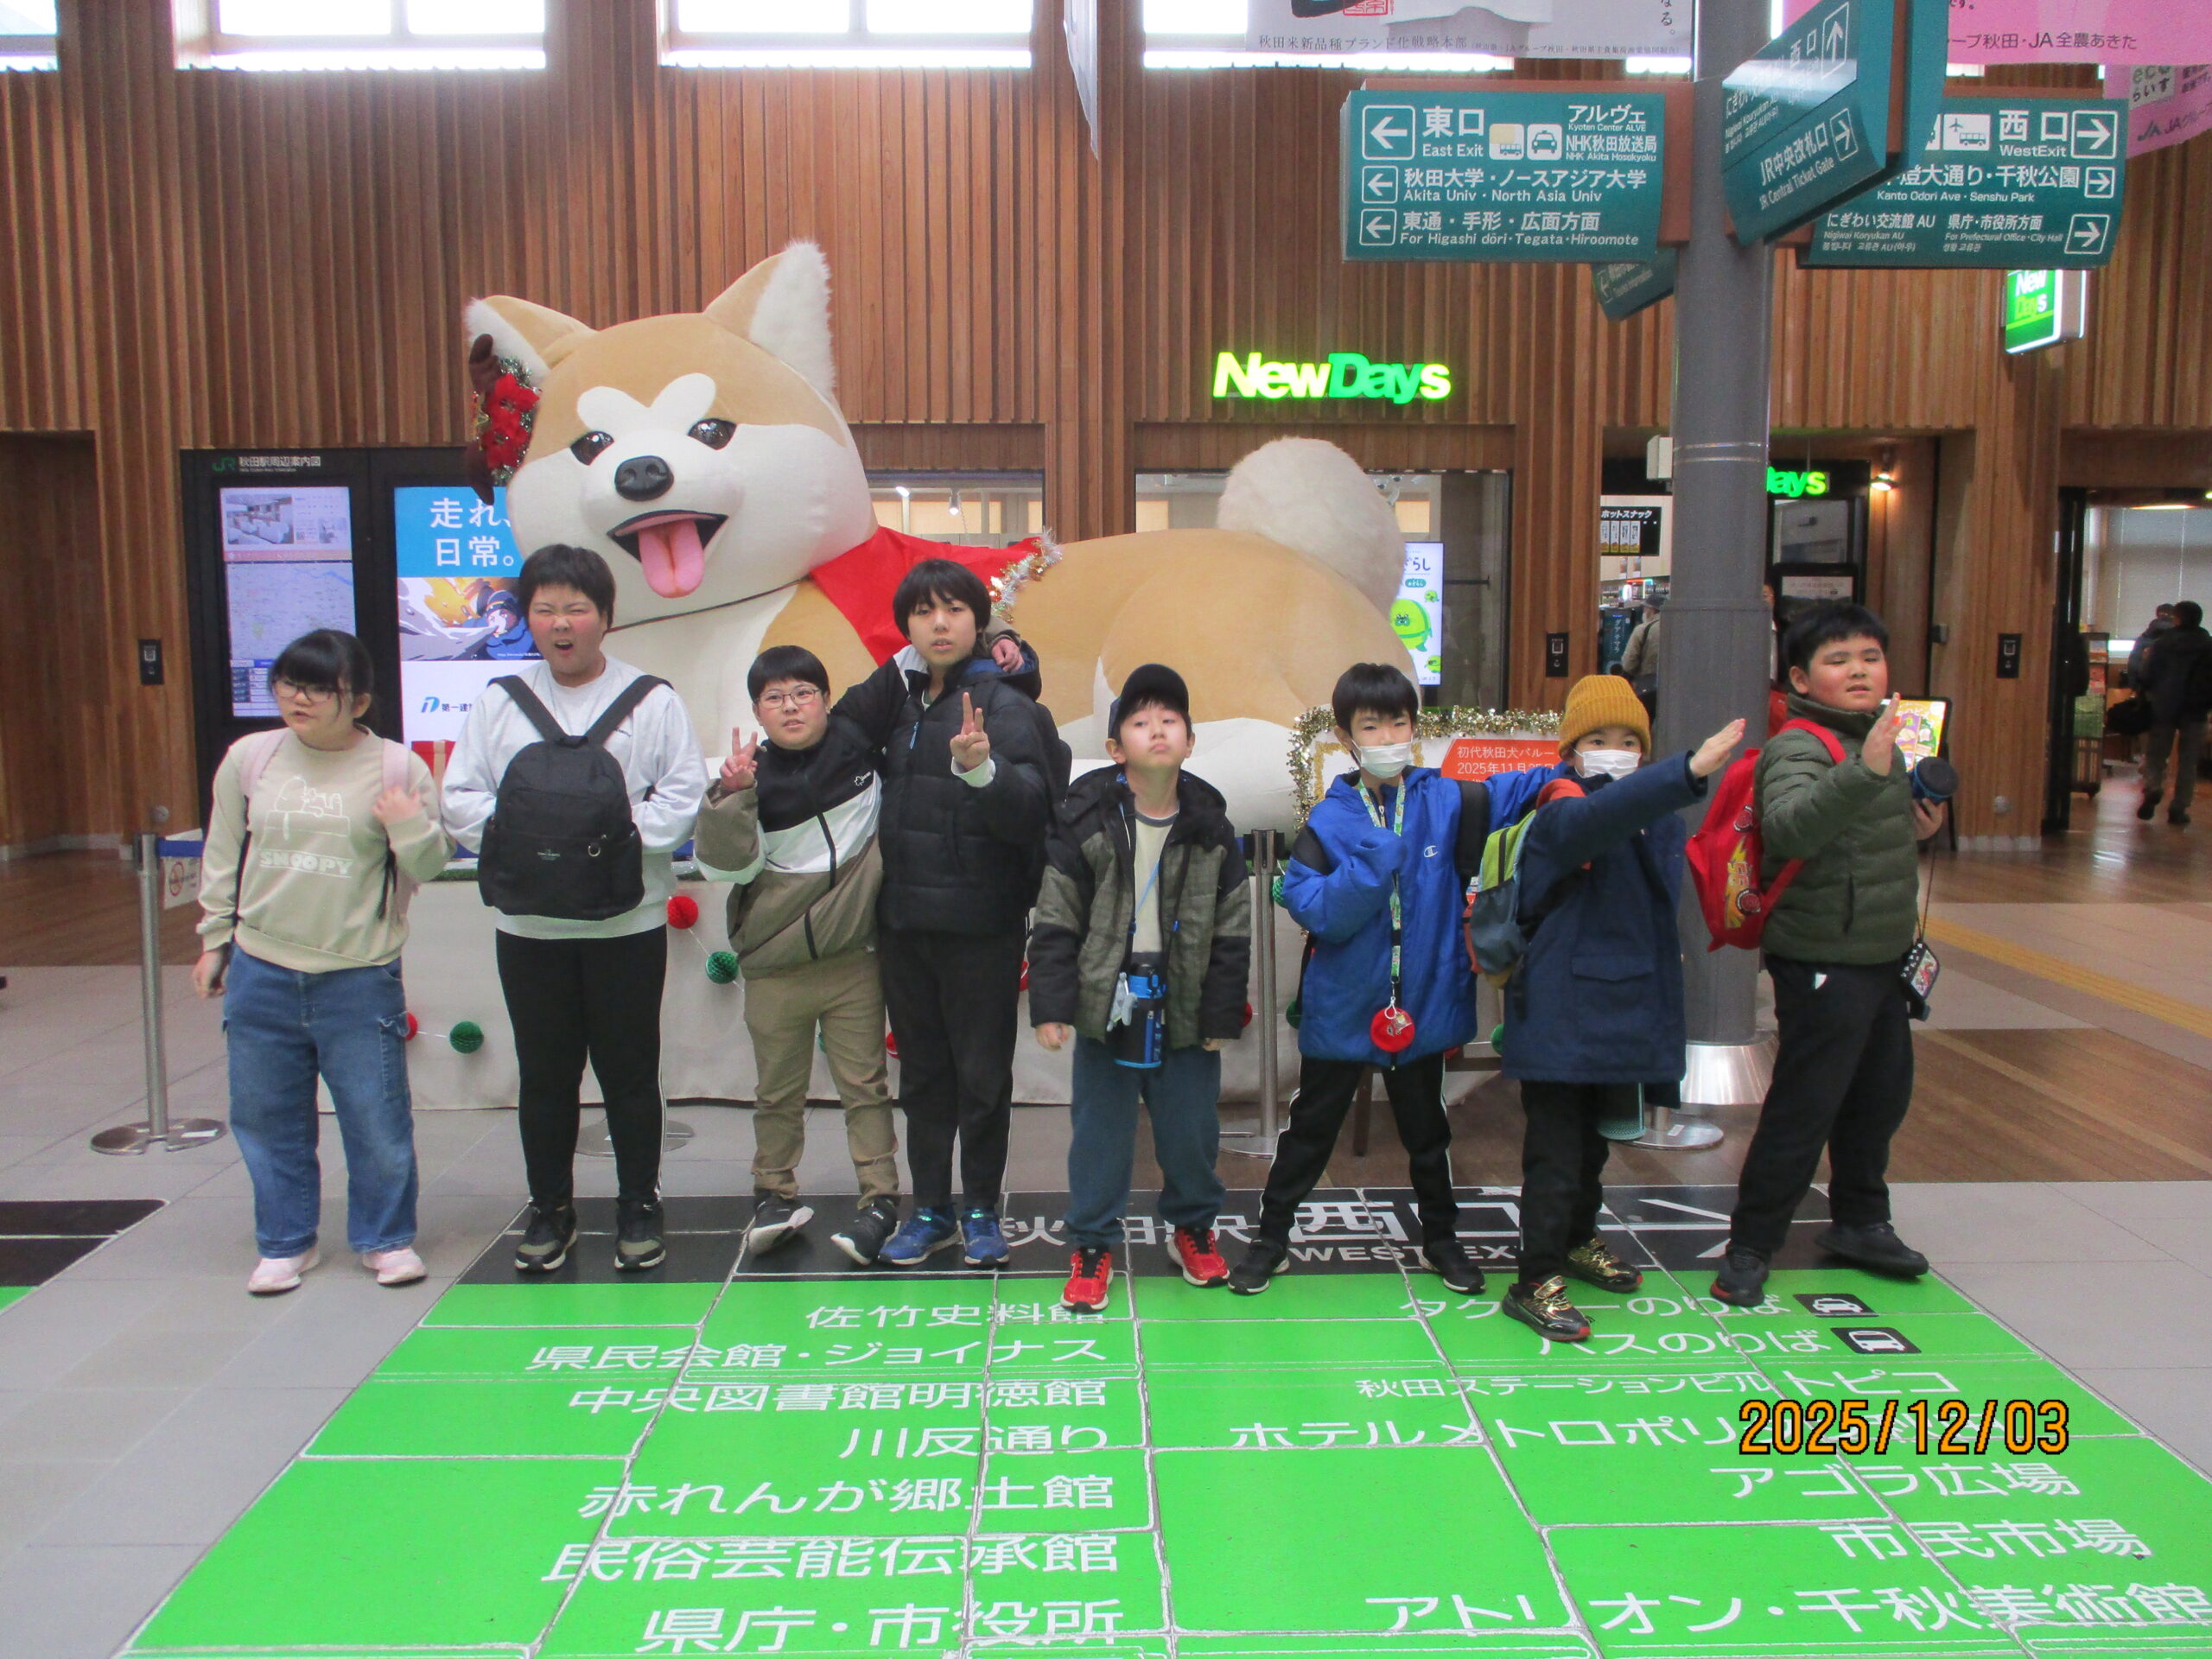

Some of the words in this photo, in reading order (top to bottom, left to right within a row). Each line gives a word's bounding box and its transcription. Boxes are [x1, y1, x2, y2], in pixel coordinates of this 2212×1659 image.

[1947, 32, 2138, 50] ープ秋田・JA全農あきた
[1422, 105, 1484, 138] 東口
[1568, 104, 1646, 124] アルヴェ
[1999, 110, 2069, 141] 西口
[1598, 124, 1624, 132] Center
[1422, 143, 1452, 157] East
[1457, 143, 1484, 157] Exit
[1566, 135, 1657, 153] NHK秋田放送局
[1760, 122, 1829, 187] JR中央改札口
[1768, 179, 1794, 204] Central
[1792, 167, 1817, 188] Ticket
[1815, 157, 1835, 175] Gate
[1887, 164, 2081, 188] 燈大通り・千秋公園
[1403, 189, 1441, 201] Akita
[1446, 190, 1477, 201] Univ
[1492, 190, 1530, 201] North
[1536, 190, 1566, 202] Asia
[1572, 190, 1602, 202] Univ
[1877, 191, 1908, 200] Kanto
[1910, 191, 1938, 200] Odori
[1940, 192, 1961, 201] Ave
[1970, 192, 2008, 202] Senshu
[2011, 193, 2035, 202] Park
[1827, 213, 1915, 230] にぎわい交流館
[1916, 214, 1936, 228] AU
[1948, 213, 2044, 231] 県庁・市役所方面
[1400, 233, 1423, 245] For
[1428, 232, 1477, 245] Higashi
[1945, 232, 1958, 241] For
[429, 498, 512, 529] 走れ、
[1601, 510, 1652, 518] ホットスナック
[435, 535, 514, 567] 日常。
[1457, 747, 1555, 759] 初代秋田犬バルー
[260, 851, 353, 874] SNOOPY
[805, 1303, 1104, 1328] 佐竹史料館
[524, 1338, 1107, 1371] 県民会館・ジョイナス
[568, 1381, 1107, 1414] 中央図書館明徳館
[839, 1424, 1109, 1459] 川反通り
[1711, 1463, 2082, 1498] アゴラ広場
[579, 1474, 1114, 1518] 赤れんが郷土館
[1820, 1518, 2152, 1560] 市民市場
[541, 1534, 1117, 1583] 民俗芸能伝承館
[634, 1599, 1123, 1654] 県庁・市役所
